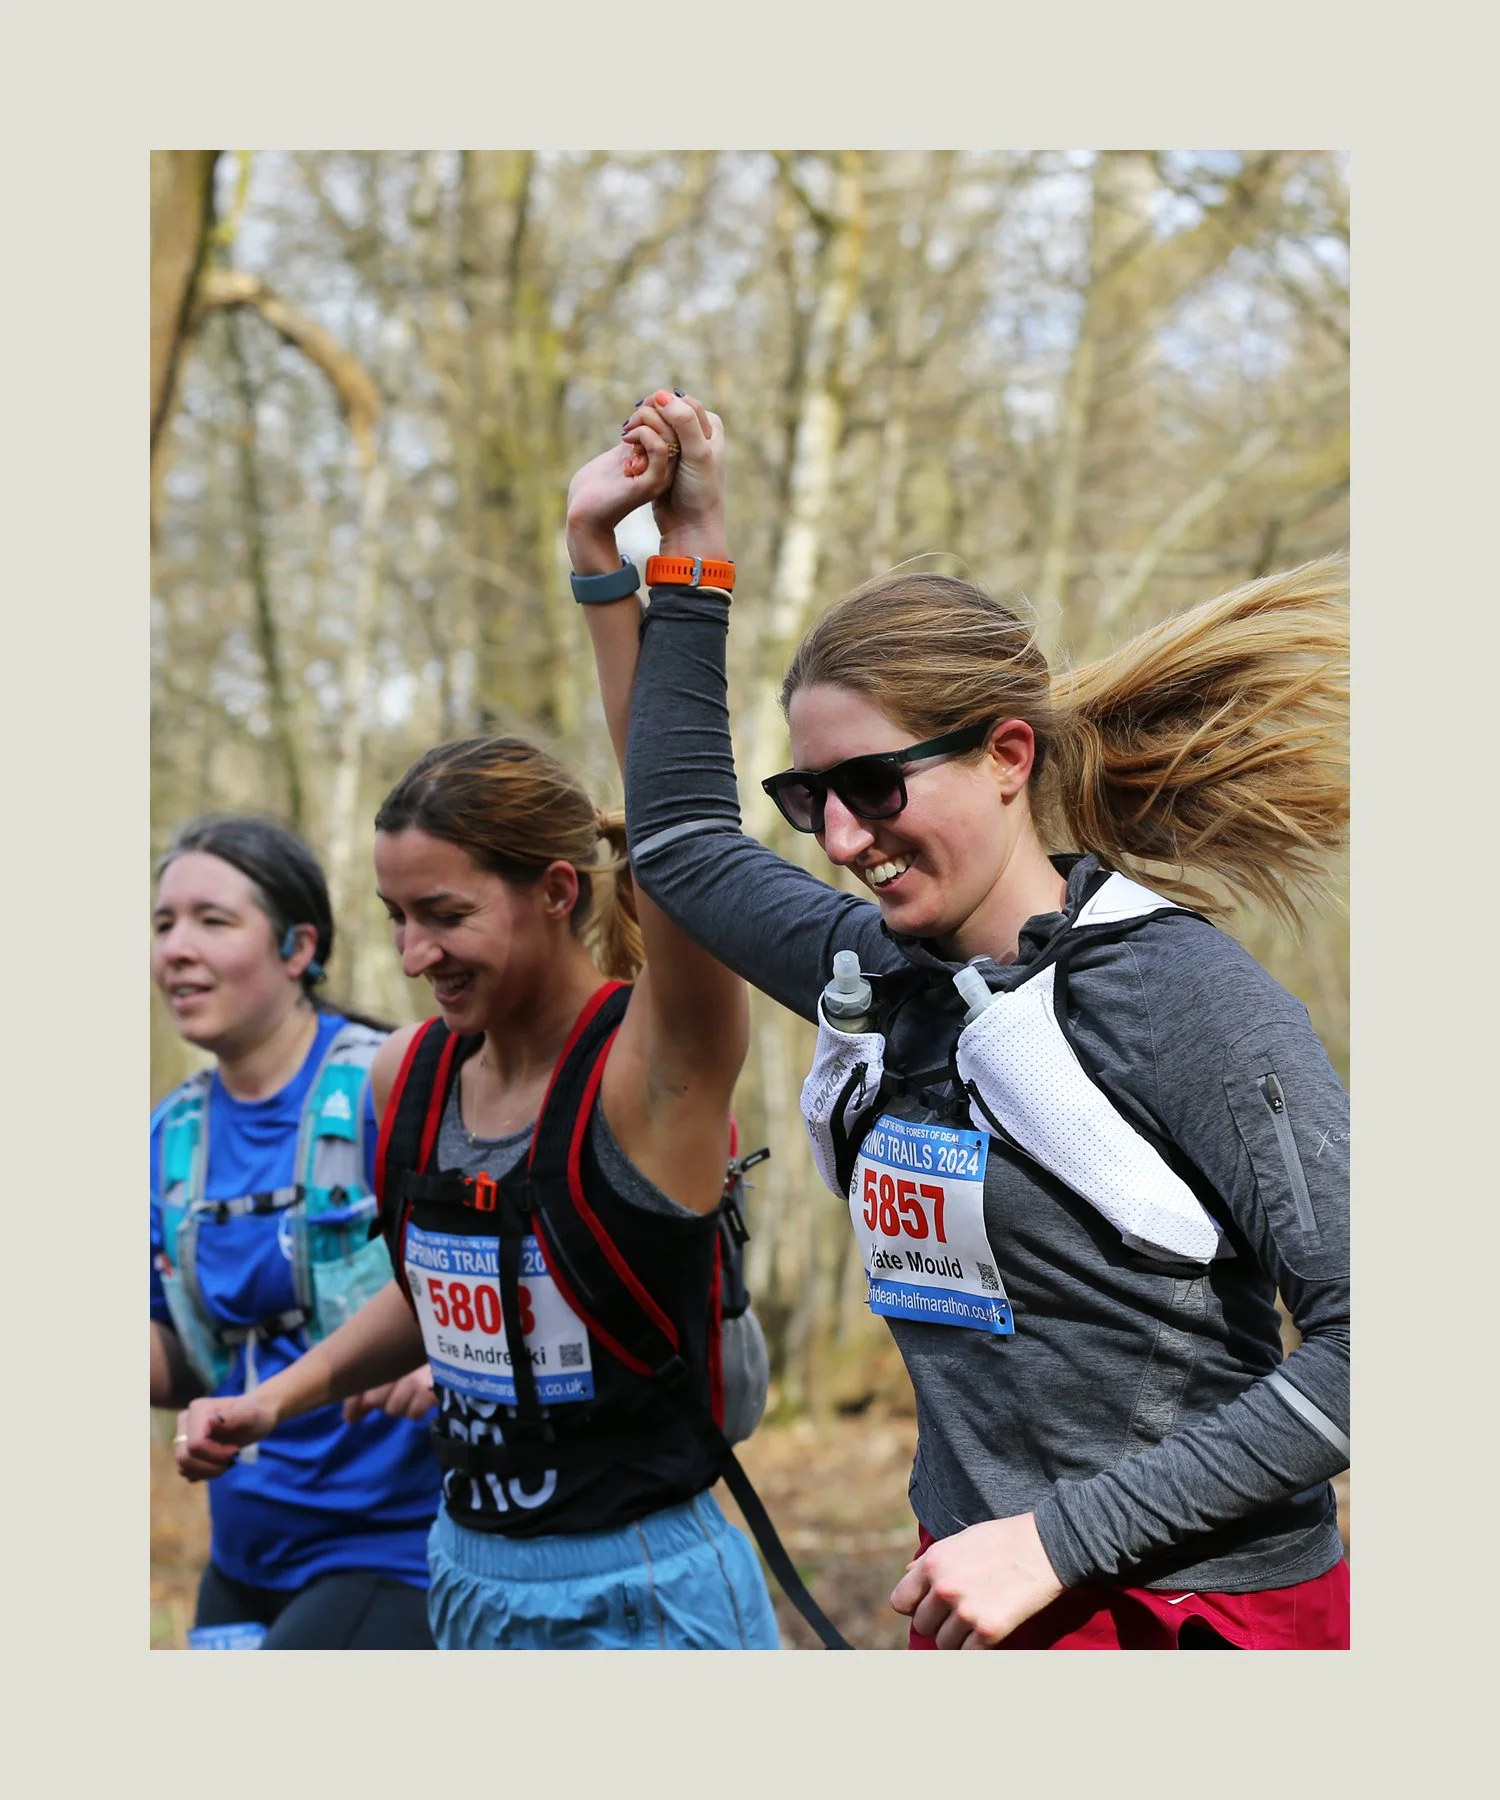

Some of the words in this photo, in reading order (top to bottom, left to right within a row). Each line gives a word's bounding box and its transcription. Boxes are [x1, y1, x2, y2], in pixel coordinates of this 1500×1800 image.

[906, 1126, 930, 1140] FOREST
[930, 1130, 941, 1140] OF
[887, 1135, 933, 1170] TRAILS
[937, 1146, 980, 1176] 2024
[863, 1168, 947, 1244] 5857
[451, 1250, 500, 1273] TRAIL
[905, 1250, 964, 1279] Mould
[437, 1335, 460, 1358] Eve
